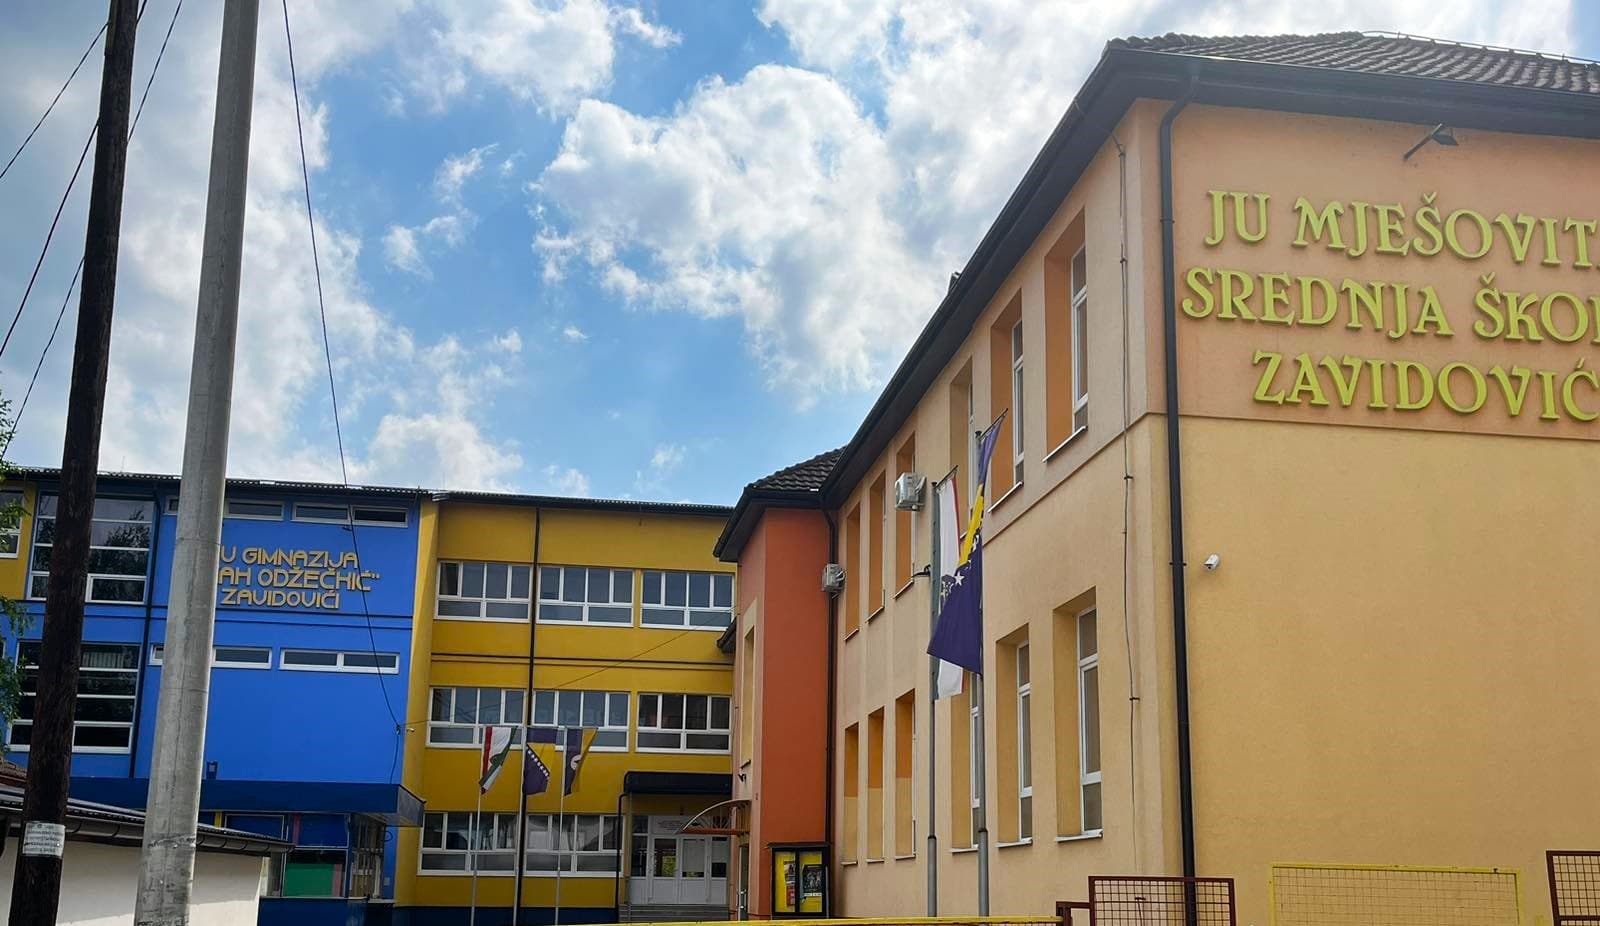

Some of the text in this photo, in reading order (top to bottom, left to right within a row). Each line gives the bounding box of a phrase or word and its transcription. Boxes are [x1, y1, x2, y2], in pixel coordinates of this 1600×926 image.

[1205, 190, 1600, 268] JU MJEŠOVIT
[1182, 267, 1454, 339] SREDNJA
[1252, 349, 1600, 421] ZAVIDOVIĆ
[218, 566, 252, 586] AH
[219, 544, 358, 569] U GIMNAZIJA
[220, 588, 340, 609] ZAVIDOVIĆI
